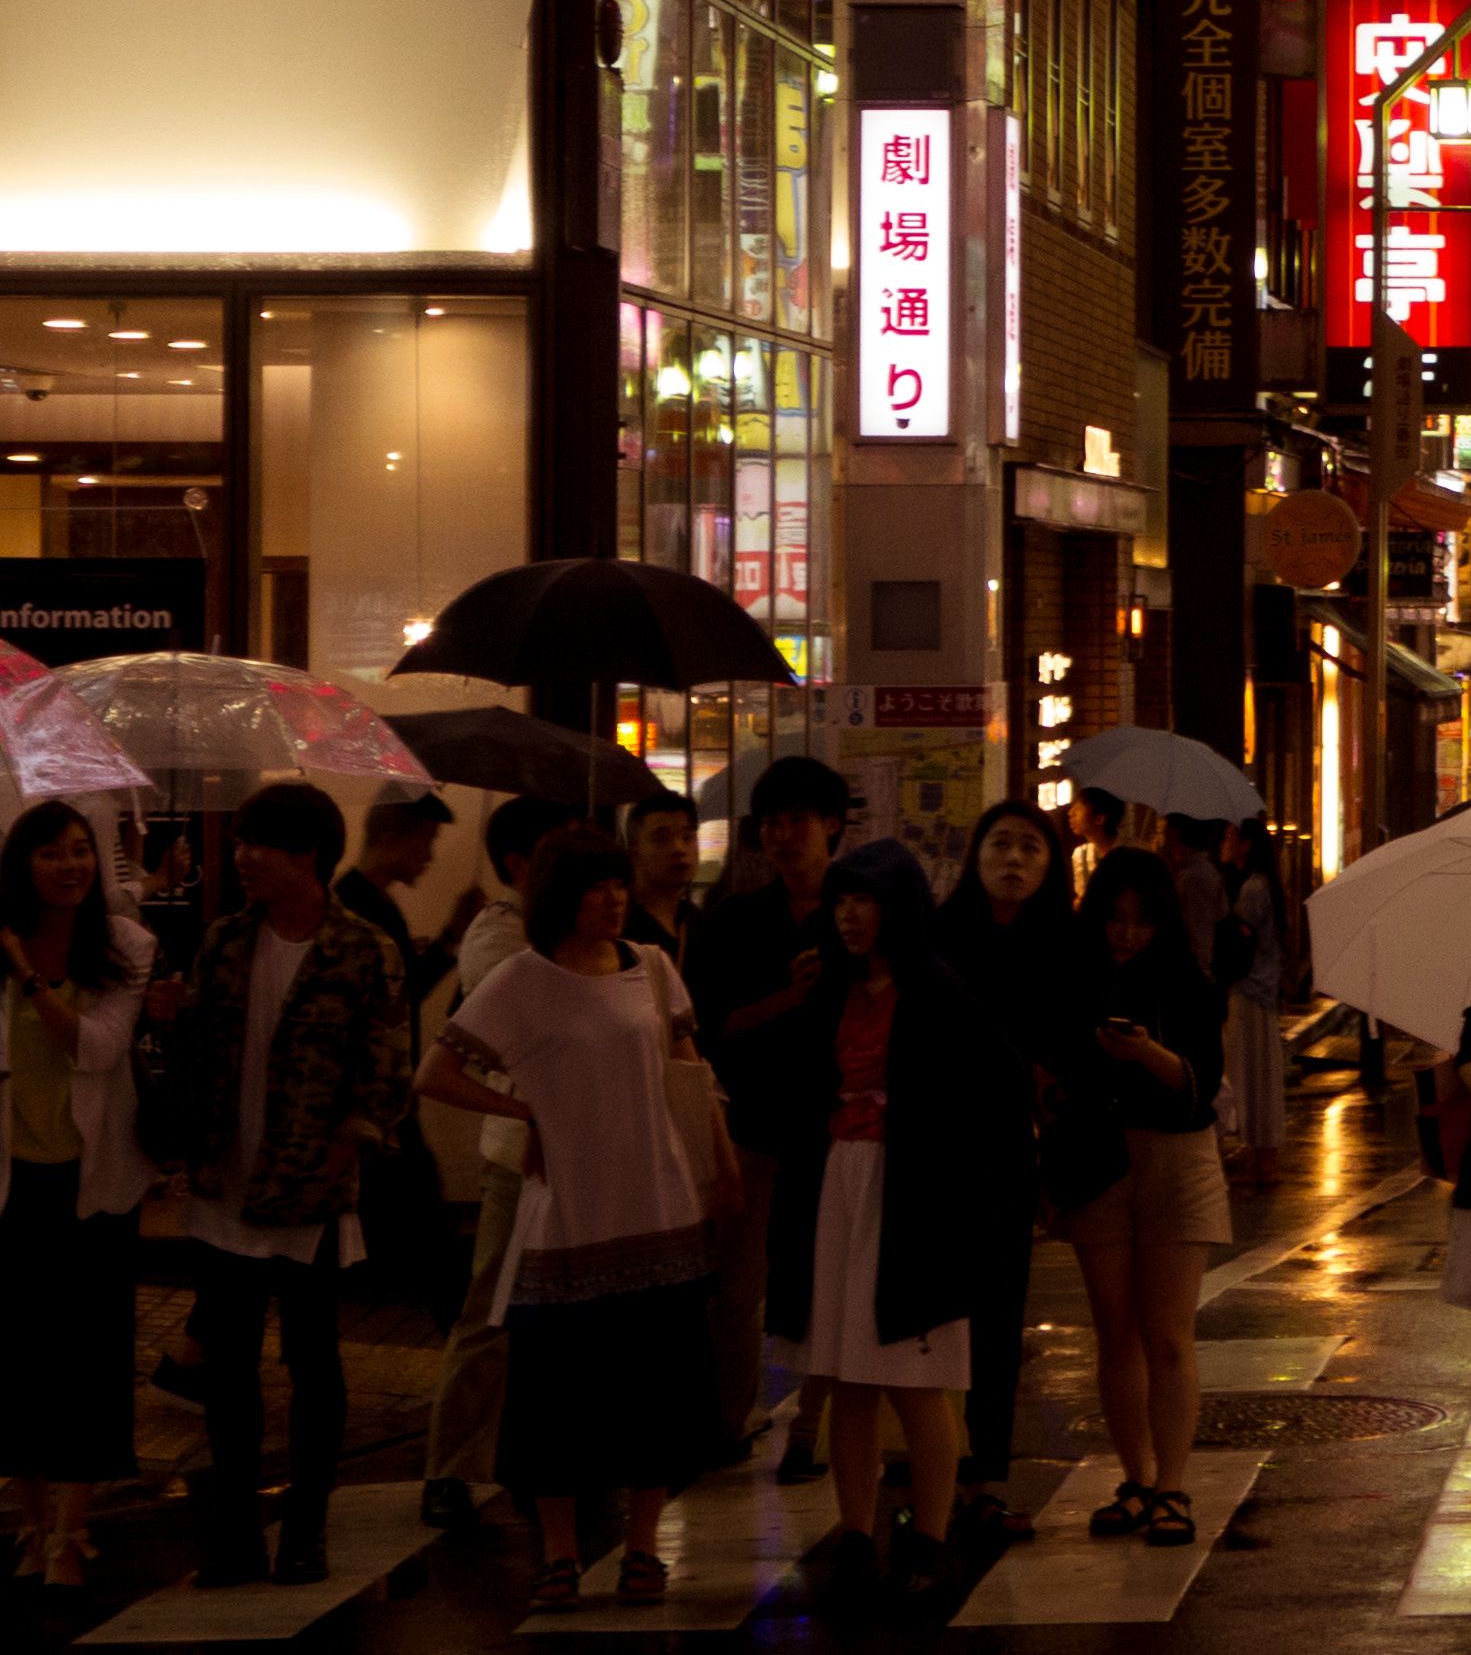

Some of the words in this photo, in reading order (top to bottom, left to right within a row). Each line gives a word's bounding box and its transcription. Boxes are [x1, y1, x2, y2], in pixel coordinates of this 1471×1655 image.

[880, 132, 932, 413] 劇場通り
[1354, 13, 1448, 323] 安楽亭
